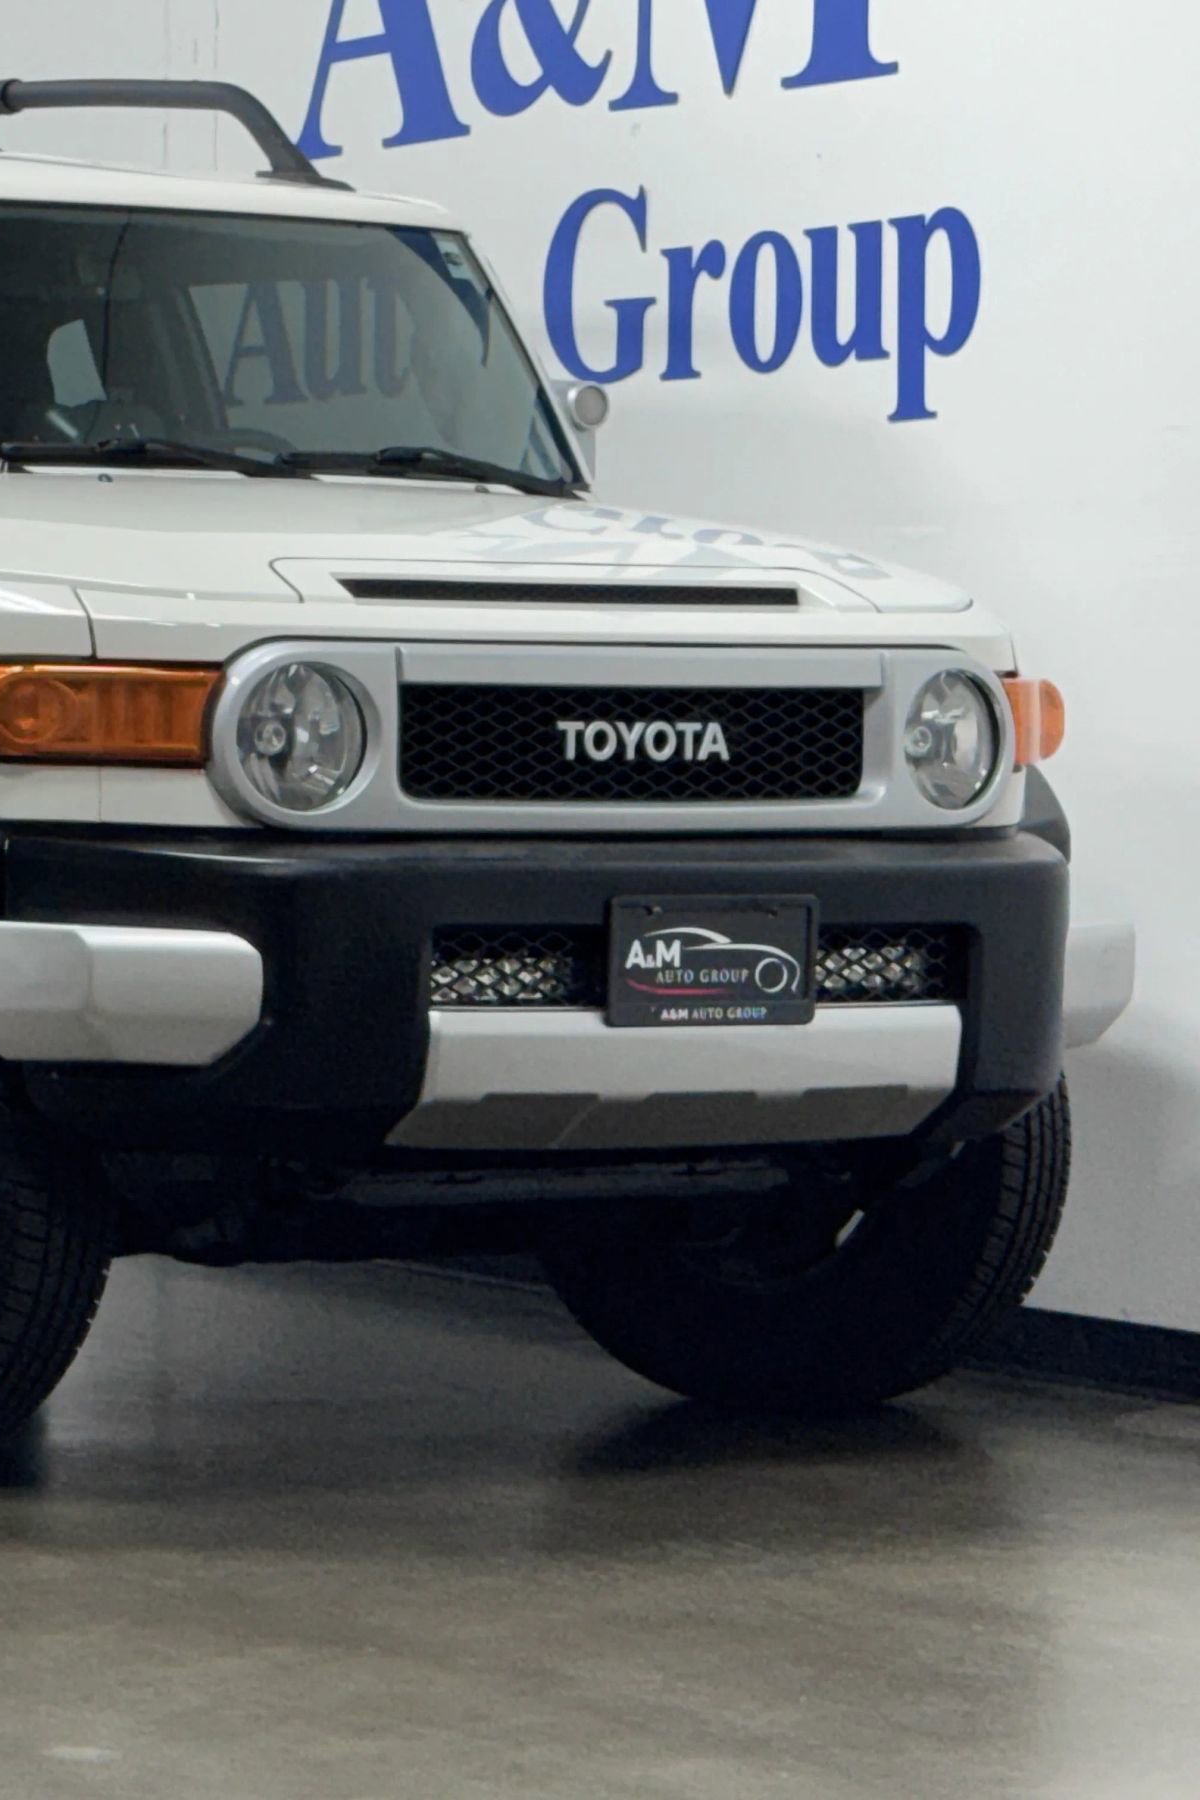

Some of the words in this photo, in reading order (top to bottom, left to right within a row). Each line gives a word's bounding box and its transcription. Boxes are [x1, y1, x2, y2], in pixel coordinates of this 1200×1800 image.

[543, 184, 982, 423] Group
[556, 720, 730, 762] TOYOTA
[625, 939, 681, 969] A&M
[655, 968, 695, 985] AUTO
[699, 967, 750, 984] GROUP
[661, 1007, 689, 1021] A&M
[692, 1007, 724, 1021] AUTO
[726, 1006, 768, 1020] GROUP
